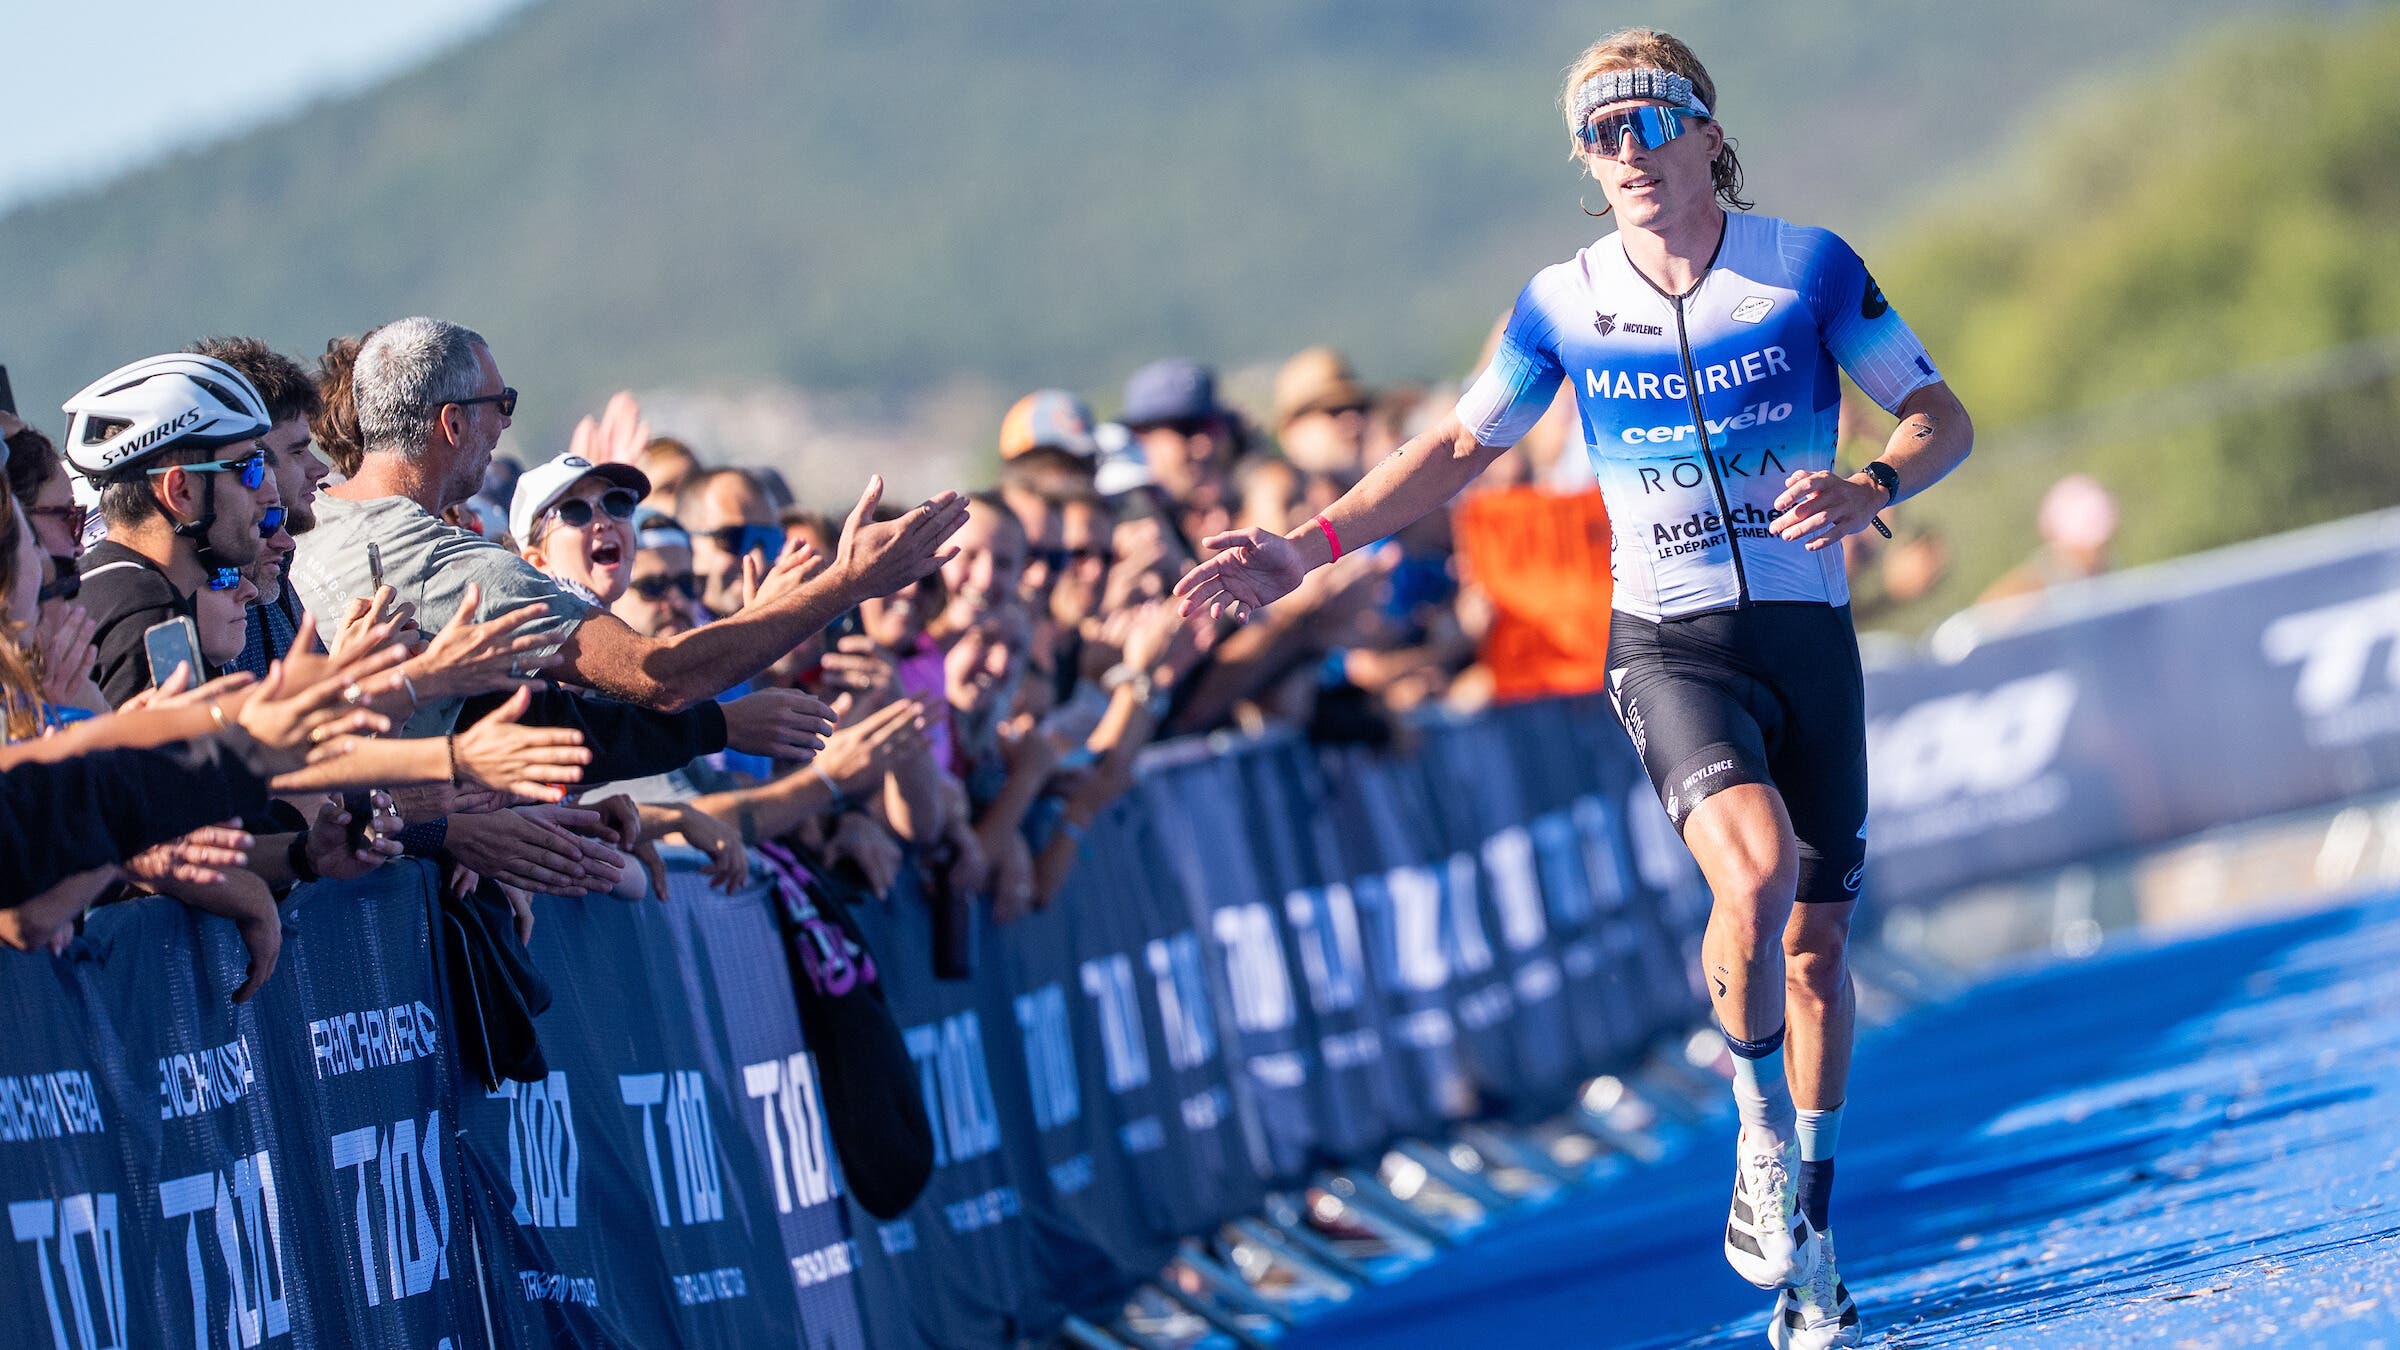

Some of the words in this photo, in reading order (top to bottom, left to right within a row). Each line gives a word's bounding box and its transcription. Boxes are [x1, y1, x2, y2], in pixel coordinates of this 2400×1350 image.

[1622, 322, 1663, 336] INCYLENCE
[1586, 346, 1791, 399] MARGIRIER
[102, 407, 200, 468] S-WORKS
[1621, 401, 1793, 445] cervélo
[1658, 547, 1673, 559] LE
[1674, 527, 1782, 555] DÉPARTEMEN
[1682, 760, 1734, 791] INCYLENCE
[486, 1071, 579, 1228] T100
[618, 1069, 724, 1227] T100
[743, 1051, 842, 1214] T10
